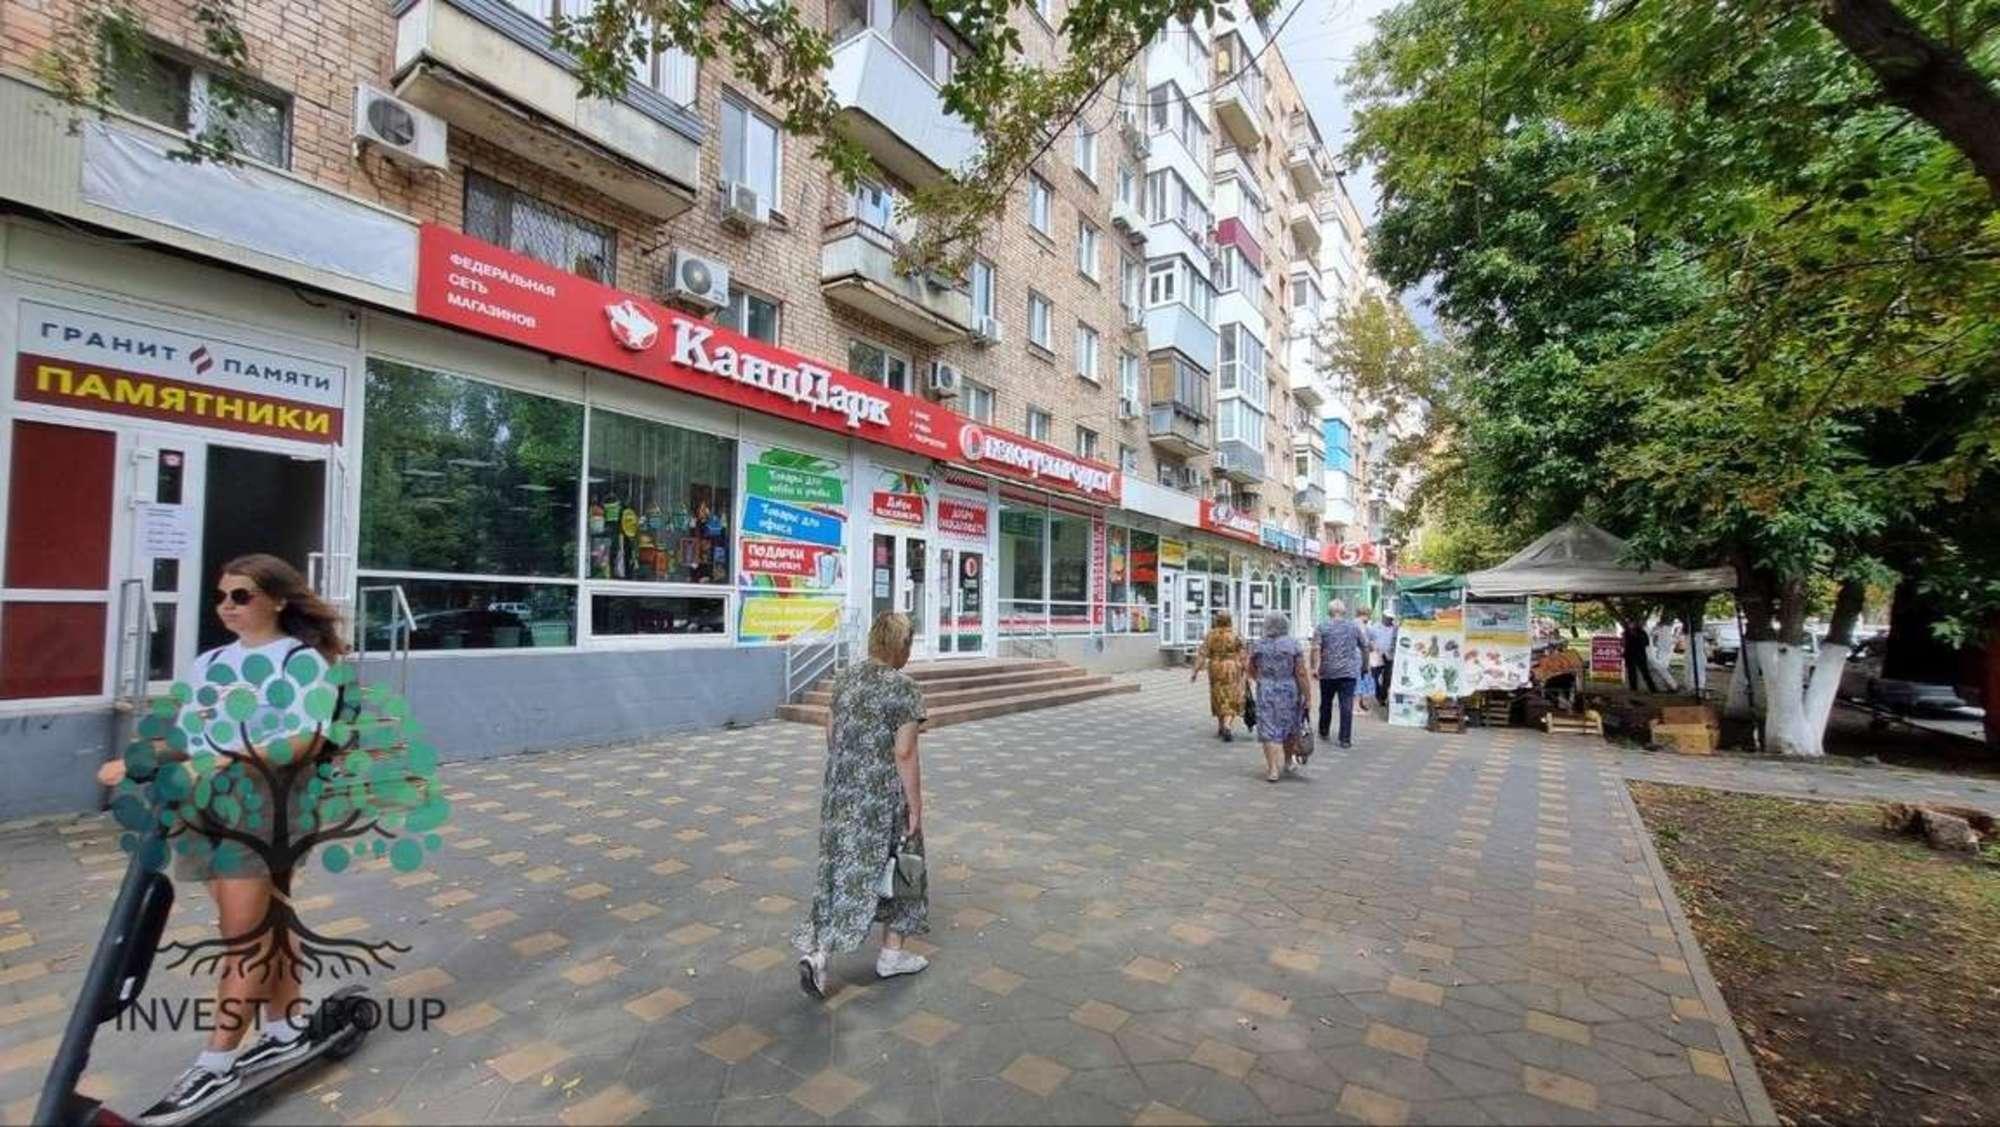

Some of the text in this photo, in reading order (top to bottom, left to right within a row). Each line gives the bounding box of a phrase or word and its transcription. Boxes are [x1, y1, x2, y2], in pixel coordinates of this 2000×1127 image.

[448, 273, 488, 295] СЕТЬ
[450, 252, 556, 297] ФЕДЕРАЛЬНАЯ
[447, 293, 536, 329] МАГАЗИНОВ
[41, 322, 330, 391] ГРАНИТ ПАМЯТИ
[37, 365, 330, 434] ПАМЯТНИКИ
[748, 544, 804, 560] ПОДАРКИ
